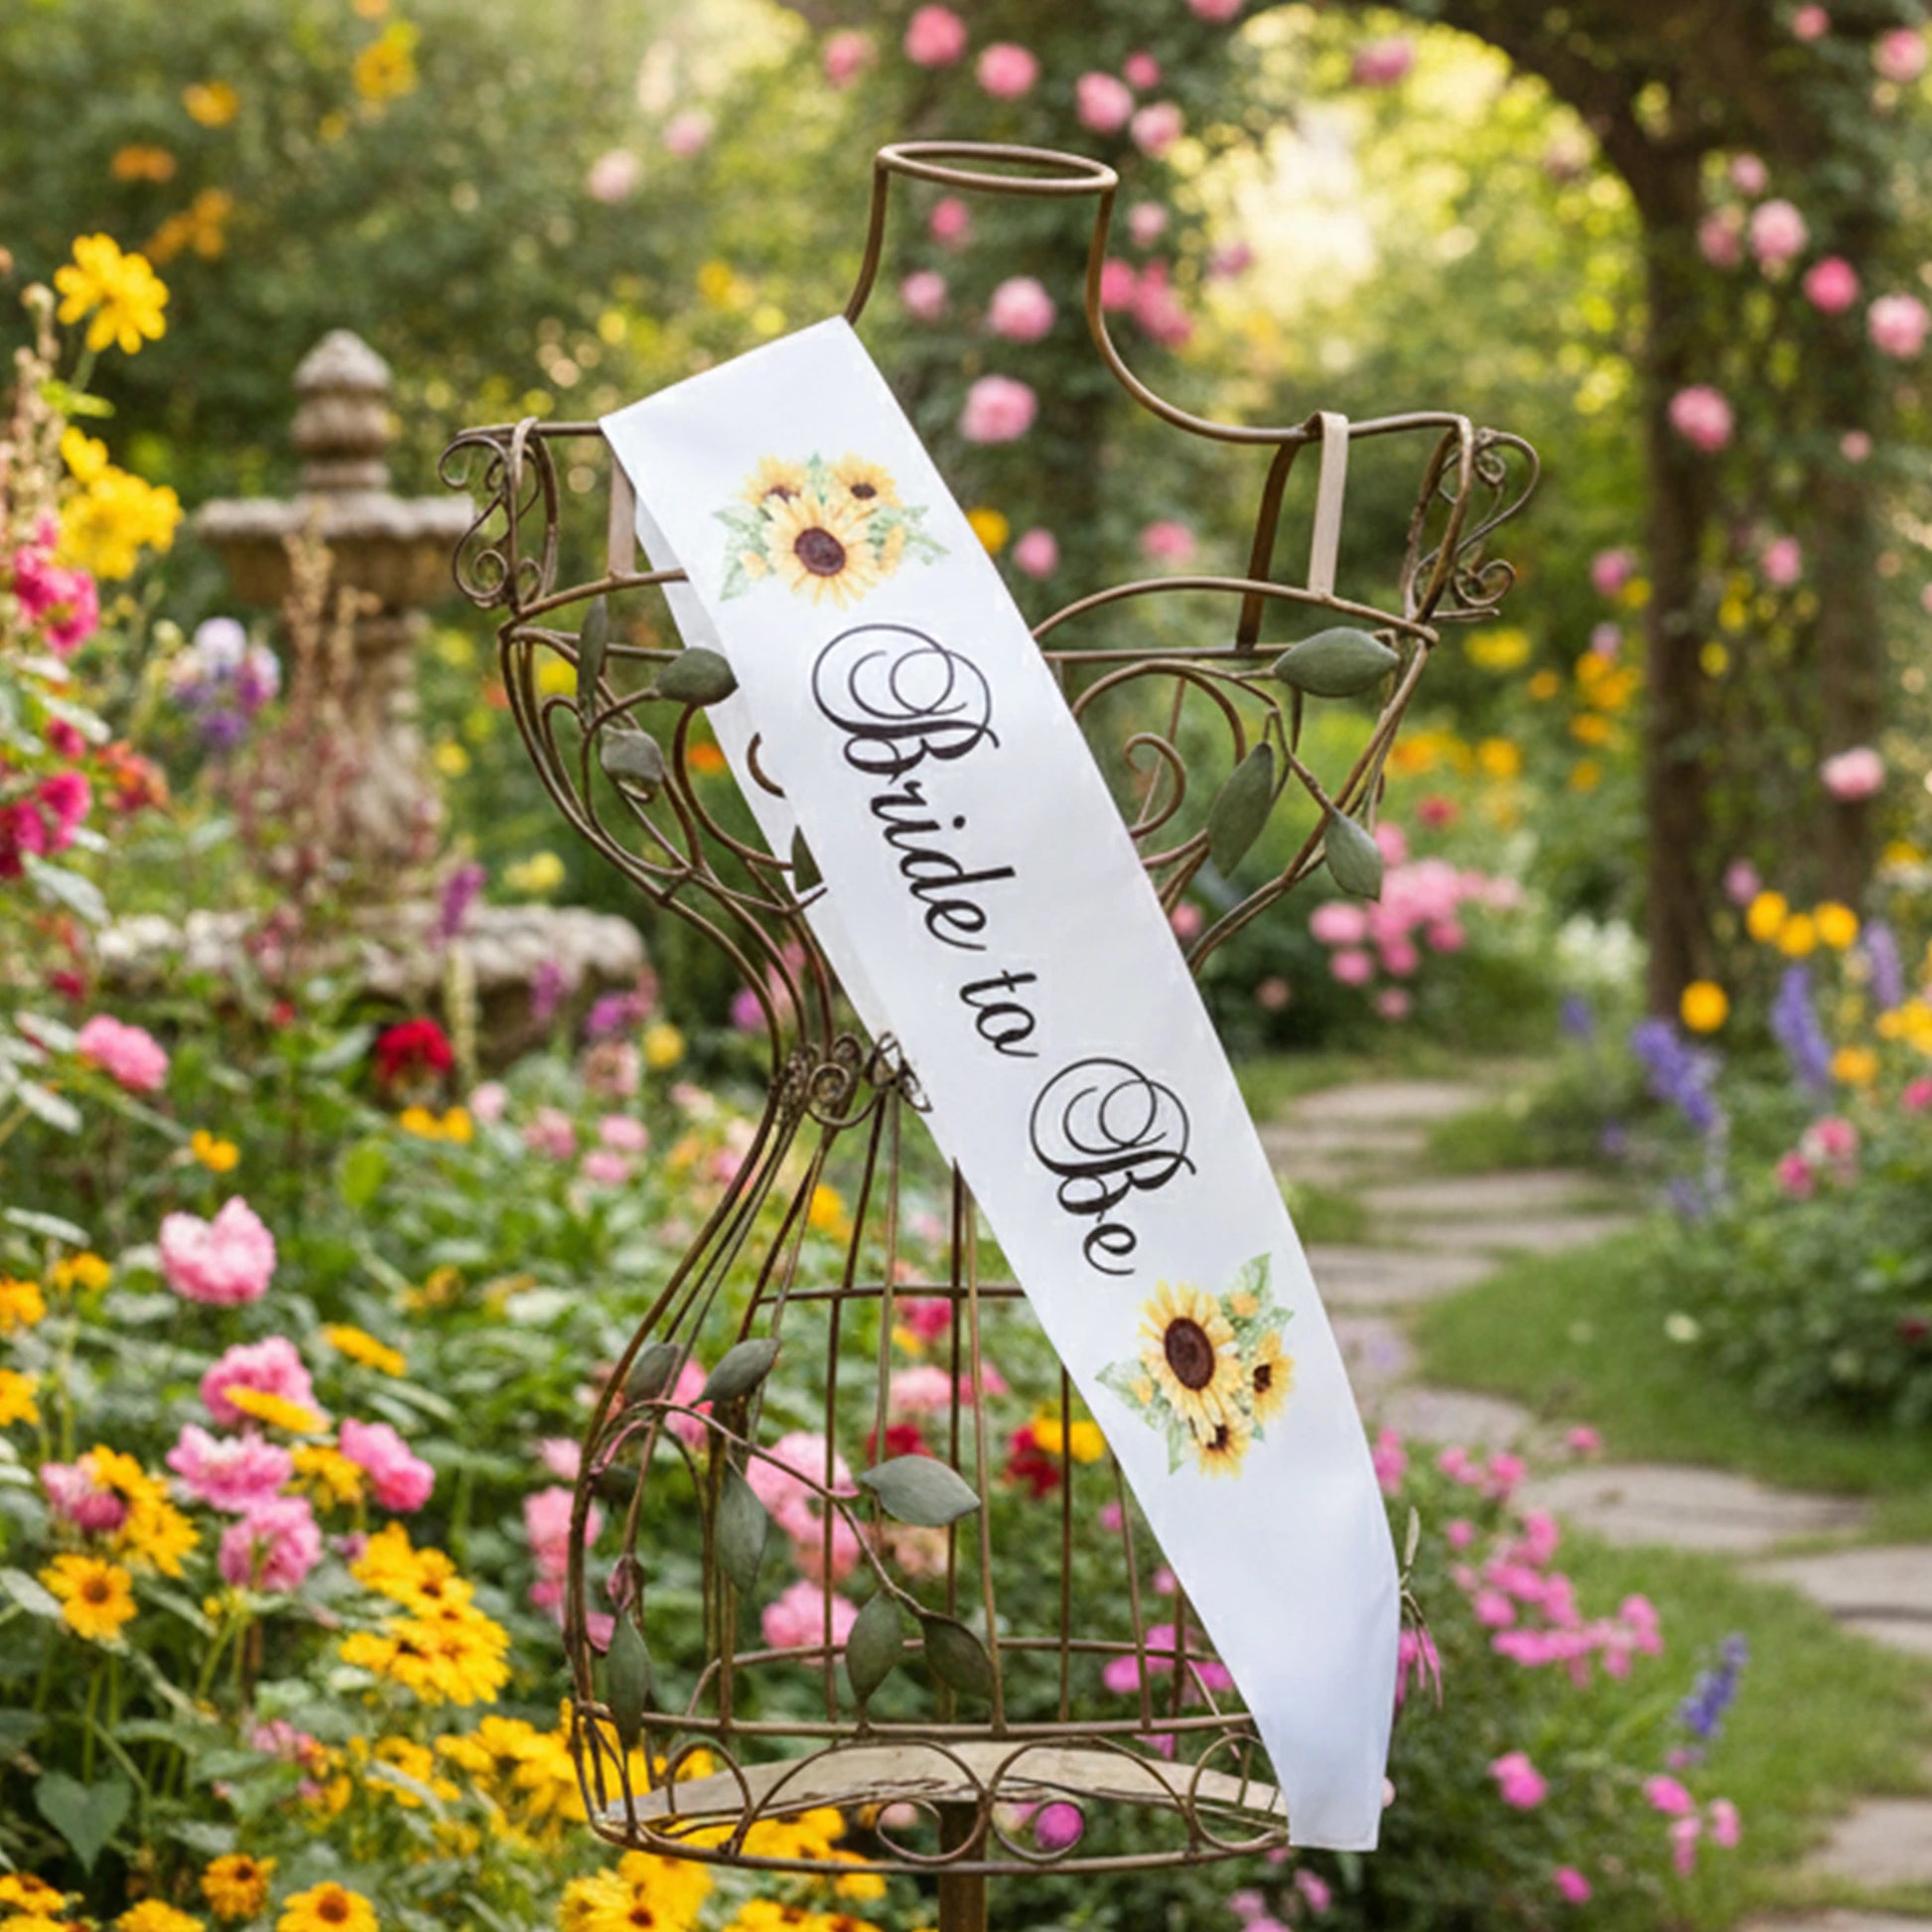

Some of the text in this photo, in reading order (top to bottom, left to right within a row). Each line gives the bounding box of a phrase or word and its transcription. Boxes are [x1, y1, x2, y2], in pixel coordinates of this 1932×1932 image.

[811, 623, 1197, 1277] Bride to Be
